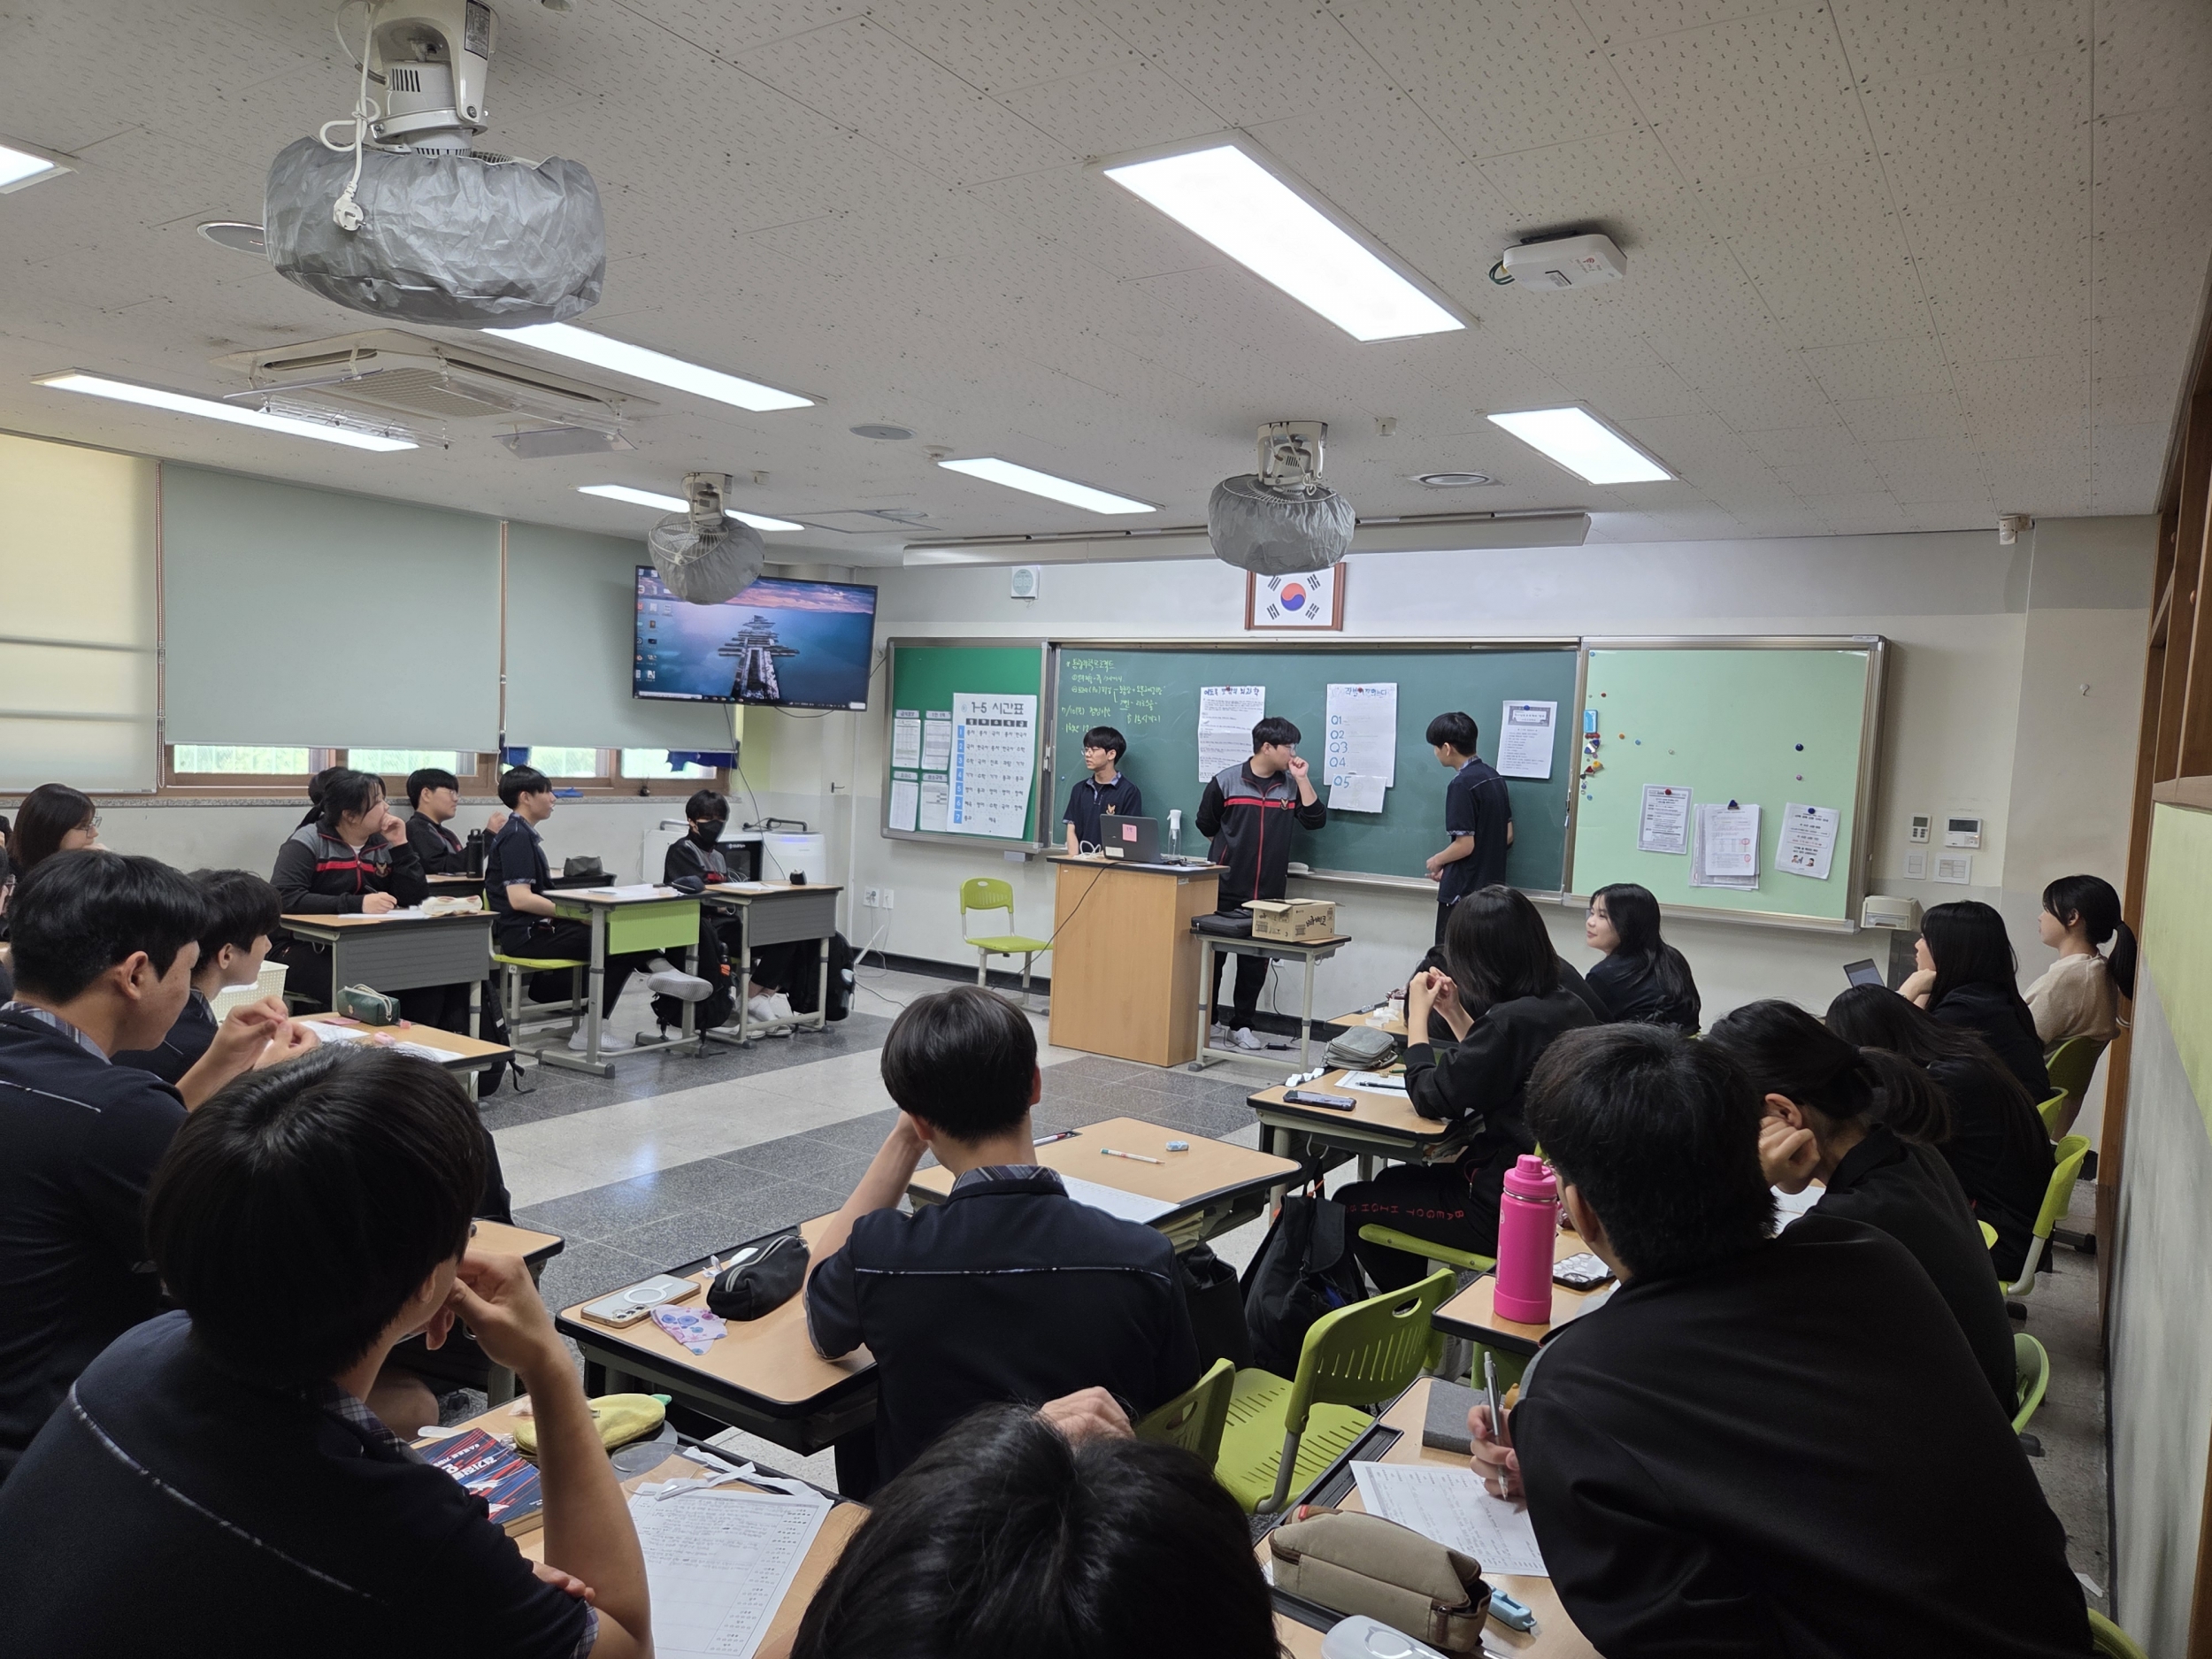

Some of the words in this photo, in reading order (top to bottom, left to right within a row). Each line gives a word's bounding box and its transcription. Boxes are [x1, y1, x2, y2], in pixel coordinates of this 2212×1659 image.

[972, 702, 987, 713] 1-5
[992, 703, 1025, 715] 시간표
[1361, 1203, 1399, 1214] HIGH
[1405, 1209, 1464, 1220] BAEGOT
